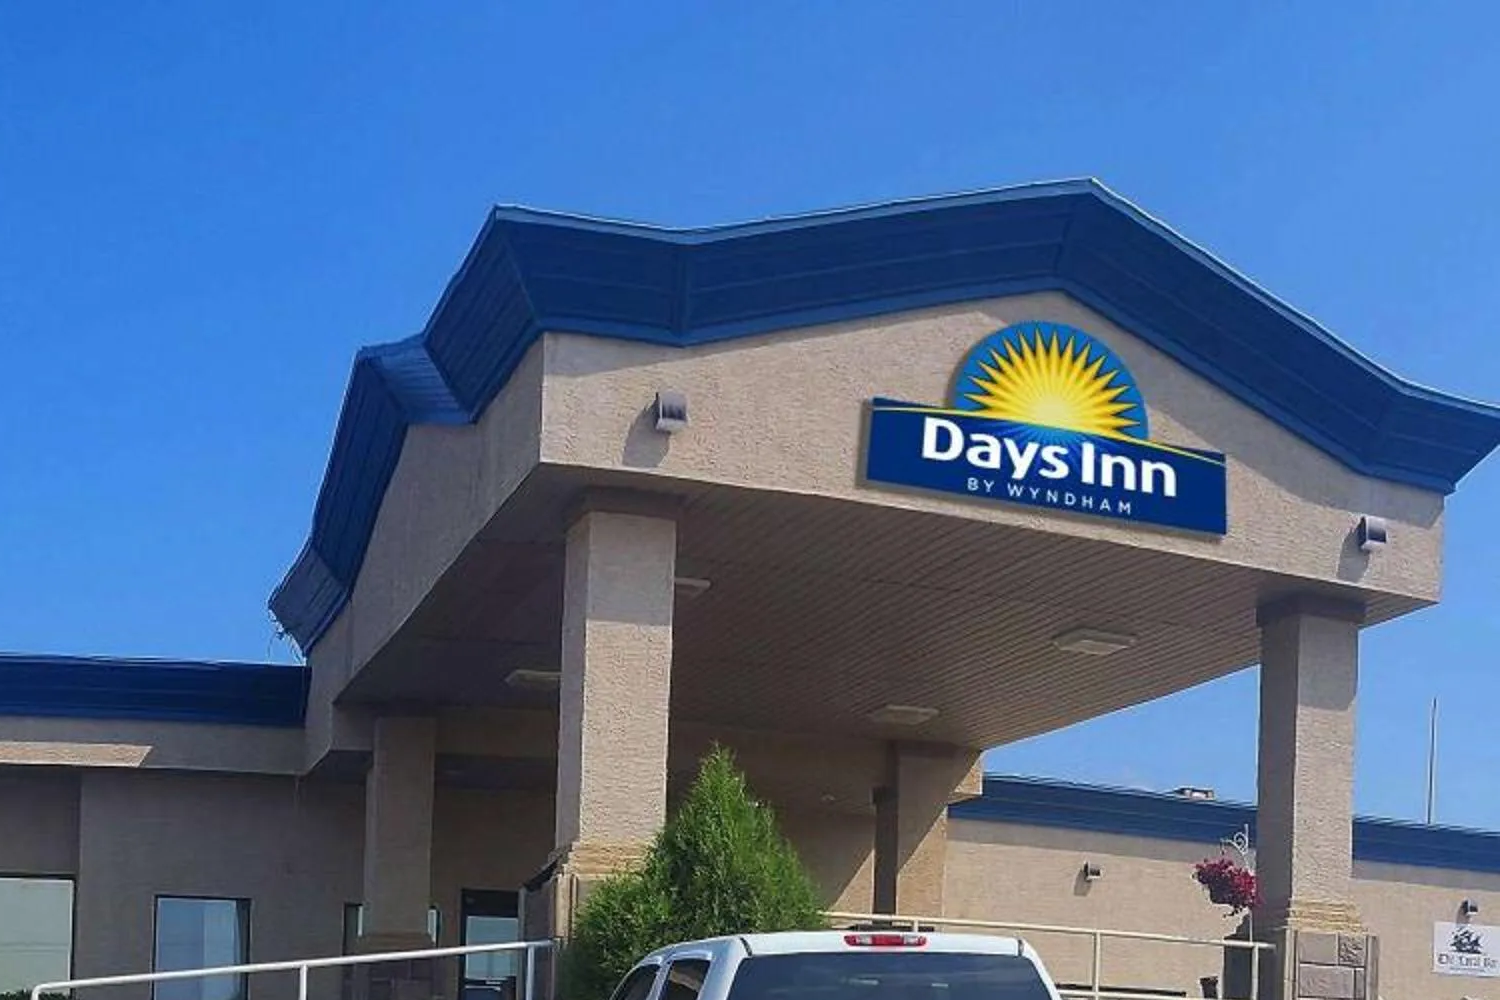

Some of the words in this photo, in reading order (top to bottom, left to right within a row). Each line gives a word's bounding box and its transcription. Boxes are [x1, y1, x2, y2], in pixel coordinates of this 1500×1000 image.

[921, 416, 1069, 480] Days
[1081, 441, 1177, 497] Inn
[966, 477, 995, 493] BY
[1007, 483, 1132, 515] WYNDHAM
